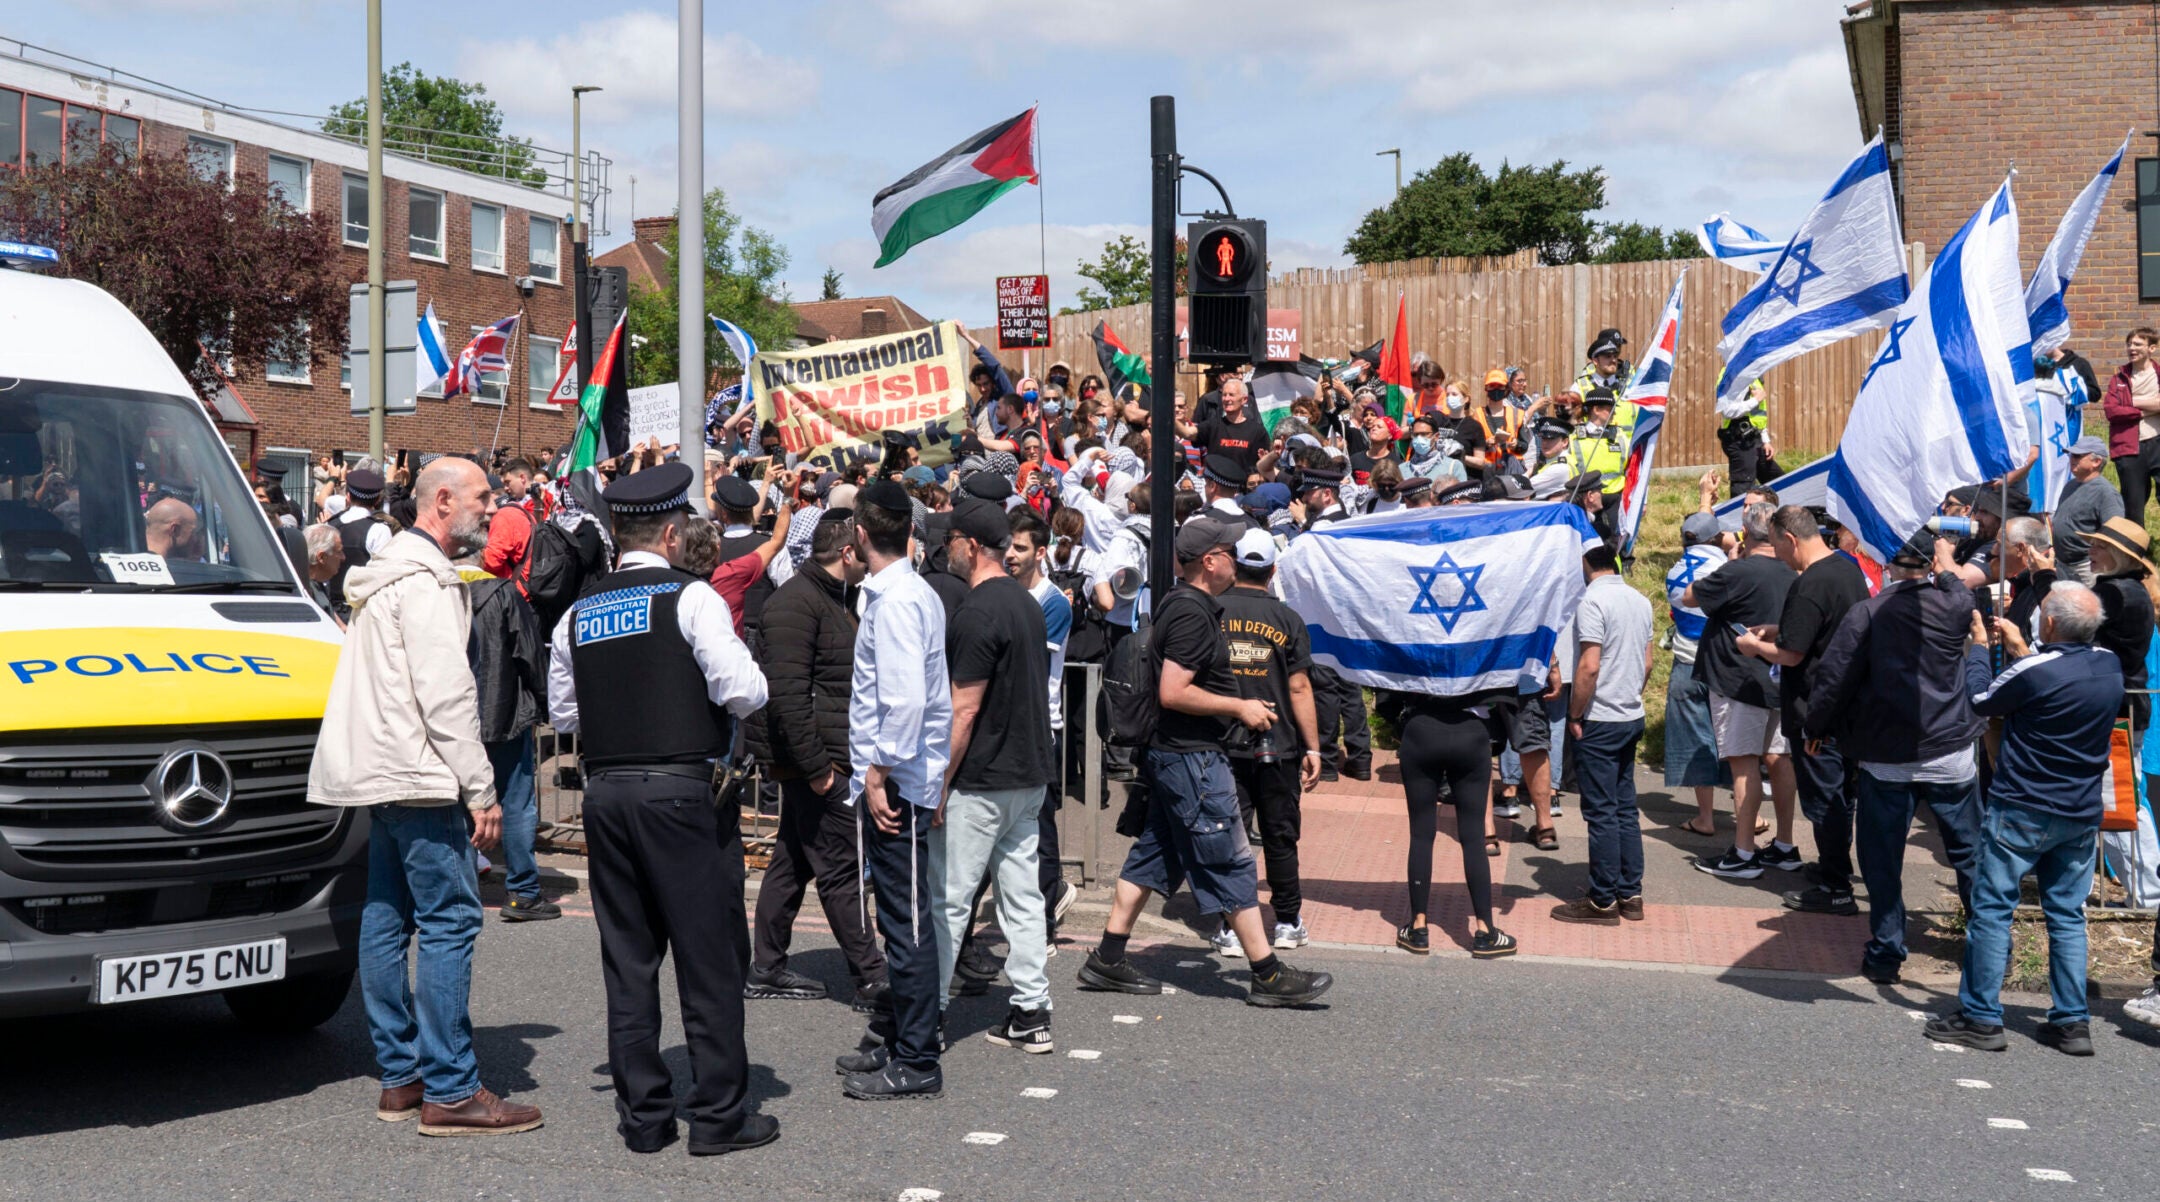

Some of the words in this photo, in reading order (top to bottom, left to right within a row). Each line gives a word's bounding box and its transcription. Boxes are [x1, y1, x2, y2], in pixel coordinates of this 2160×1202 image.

[999, 287, 1020, 297] HANDS
[1021, 286, 1034, 296] OFF
[1000, 278, 1017, 289] GET
[1019, 277, 1037, 287] YOUR
[1000, 308, 1024, 318] THEIR
[1026, 308, 1047, 317] LAND
[1000, 319, 1011, 327] IS
[1013, 319, 1028, 328] NOT
[760, 325, 944, 390] International
[770, 363, 950, 424] Jewish
[808, 419, 951, 473] etwrk
[118, 561, 162, 572] 106B
[580, 599, 647, 618] METROPOLITAN
[578, 609, 646, 641] POLICE
[1229, 619, 1242, 632] IN
[1245, 620, 1288, 646] DETROI
[8, 652, 291, 684] POLICE
[116, 953, 205, 995] KP75
[215, 944, 273, 981] CNU
[1035, 1031, 1051, 1043] NIK
